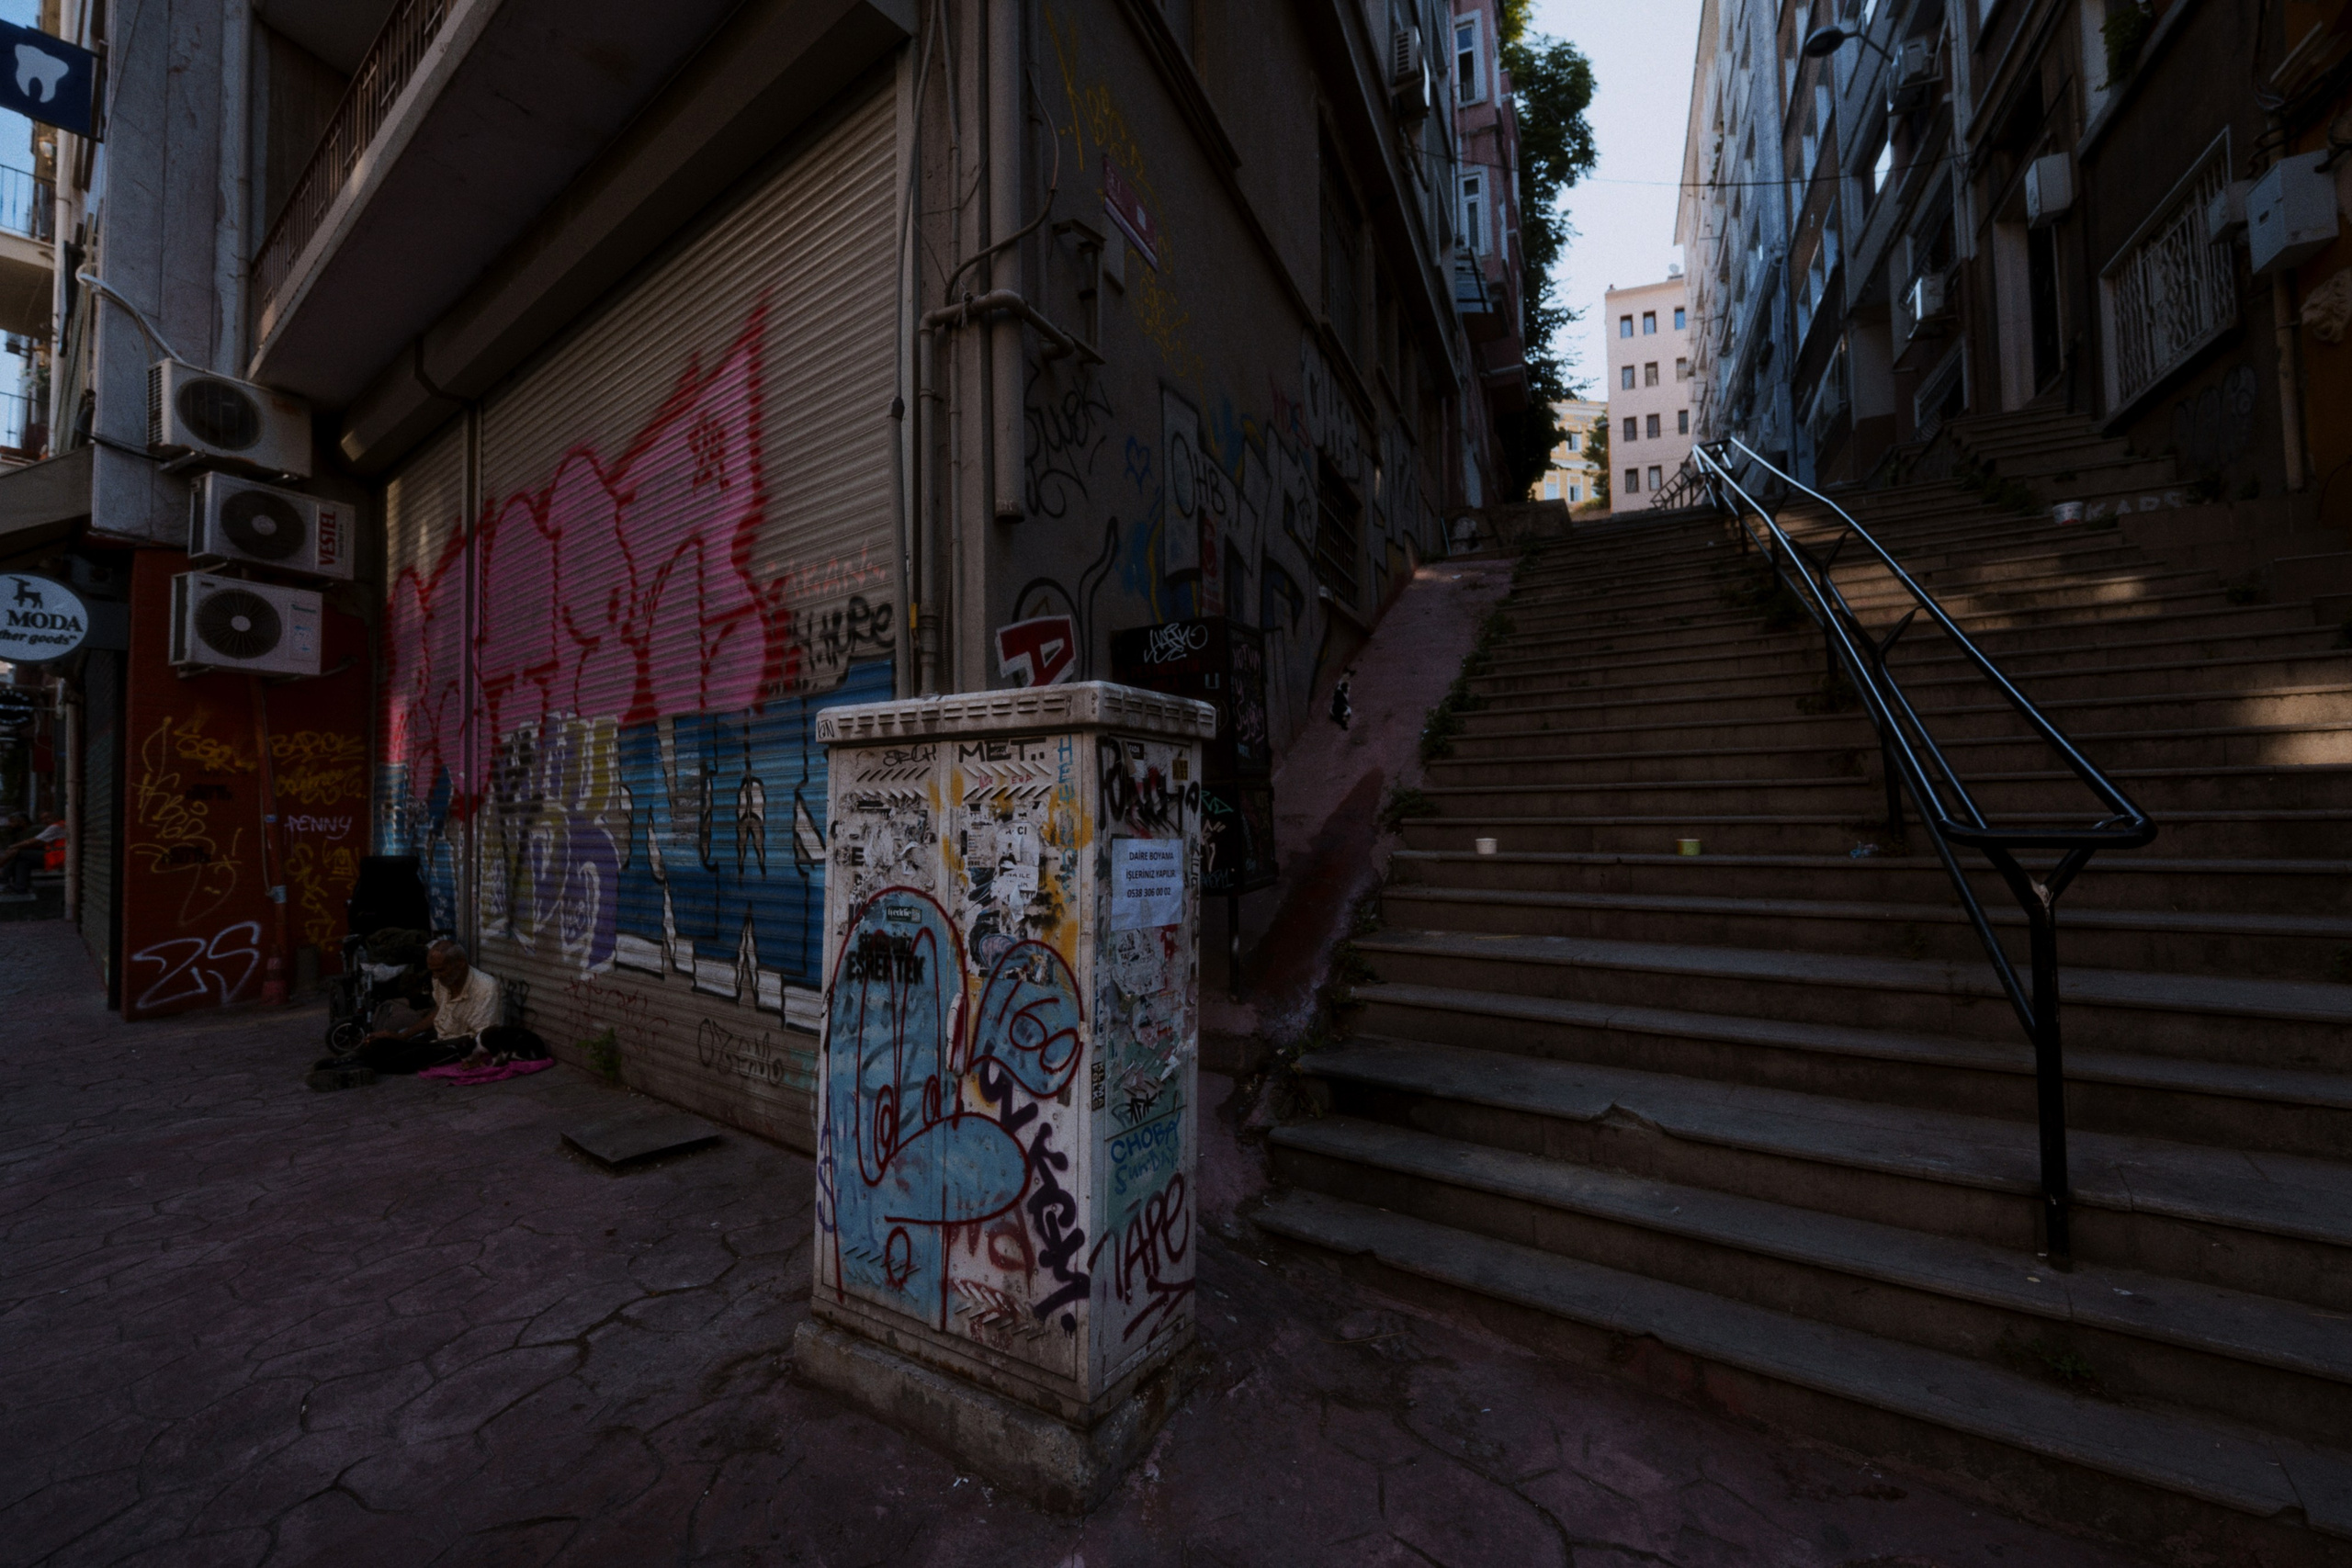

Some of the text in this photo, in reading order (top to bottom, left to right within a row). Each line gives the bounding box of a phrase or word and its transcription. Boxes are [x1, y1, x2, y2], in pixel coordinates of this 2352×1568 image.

[319, 511, 336, 566] VESTEL
[6, 609, 84, 633] MODA
[1149, 851, 1174, 861] BOYAMA
[1155, 886, 1163, 897] 00
[1163, 886, 1171, 897] 02
